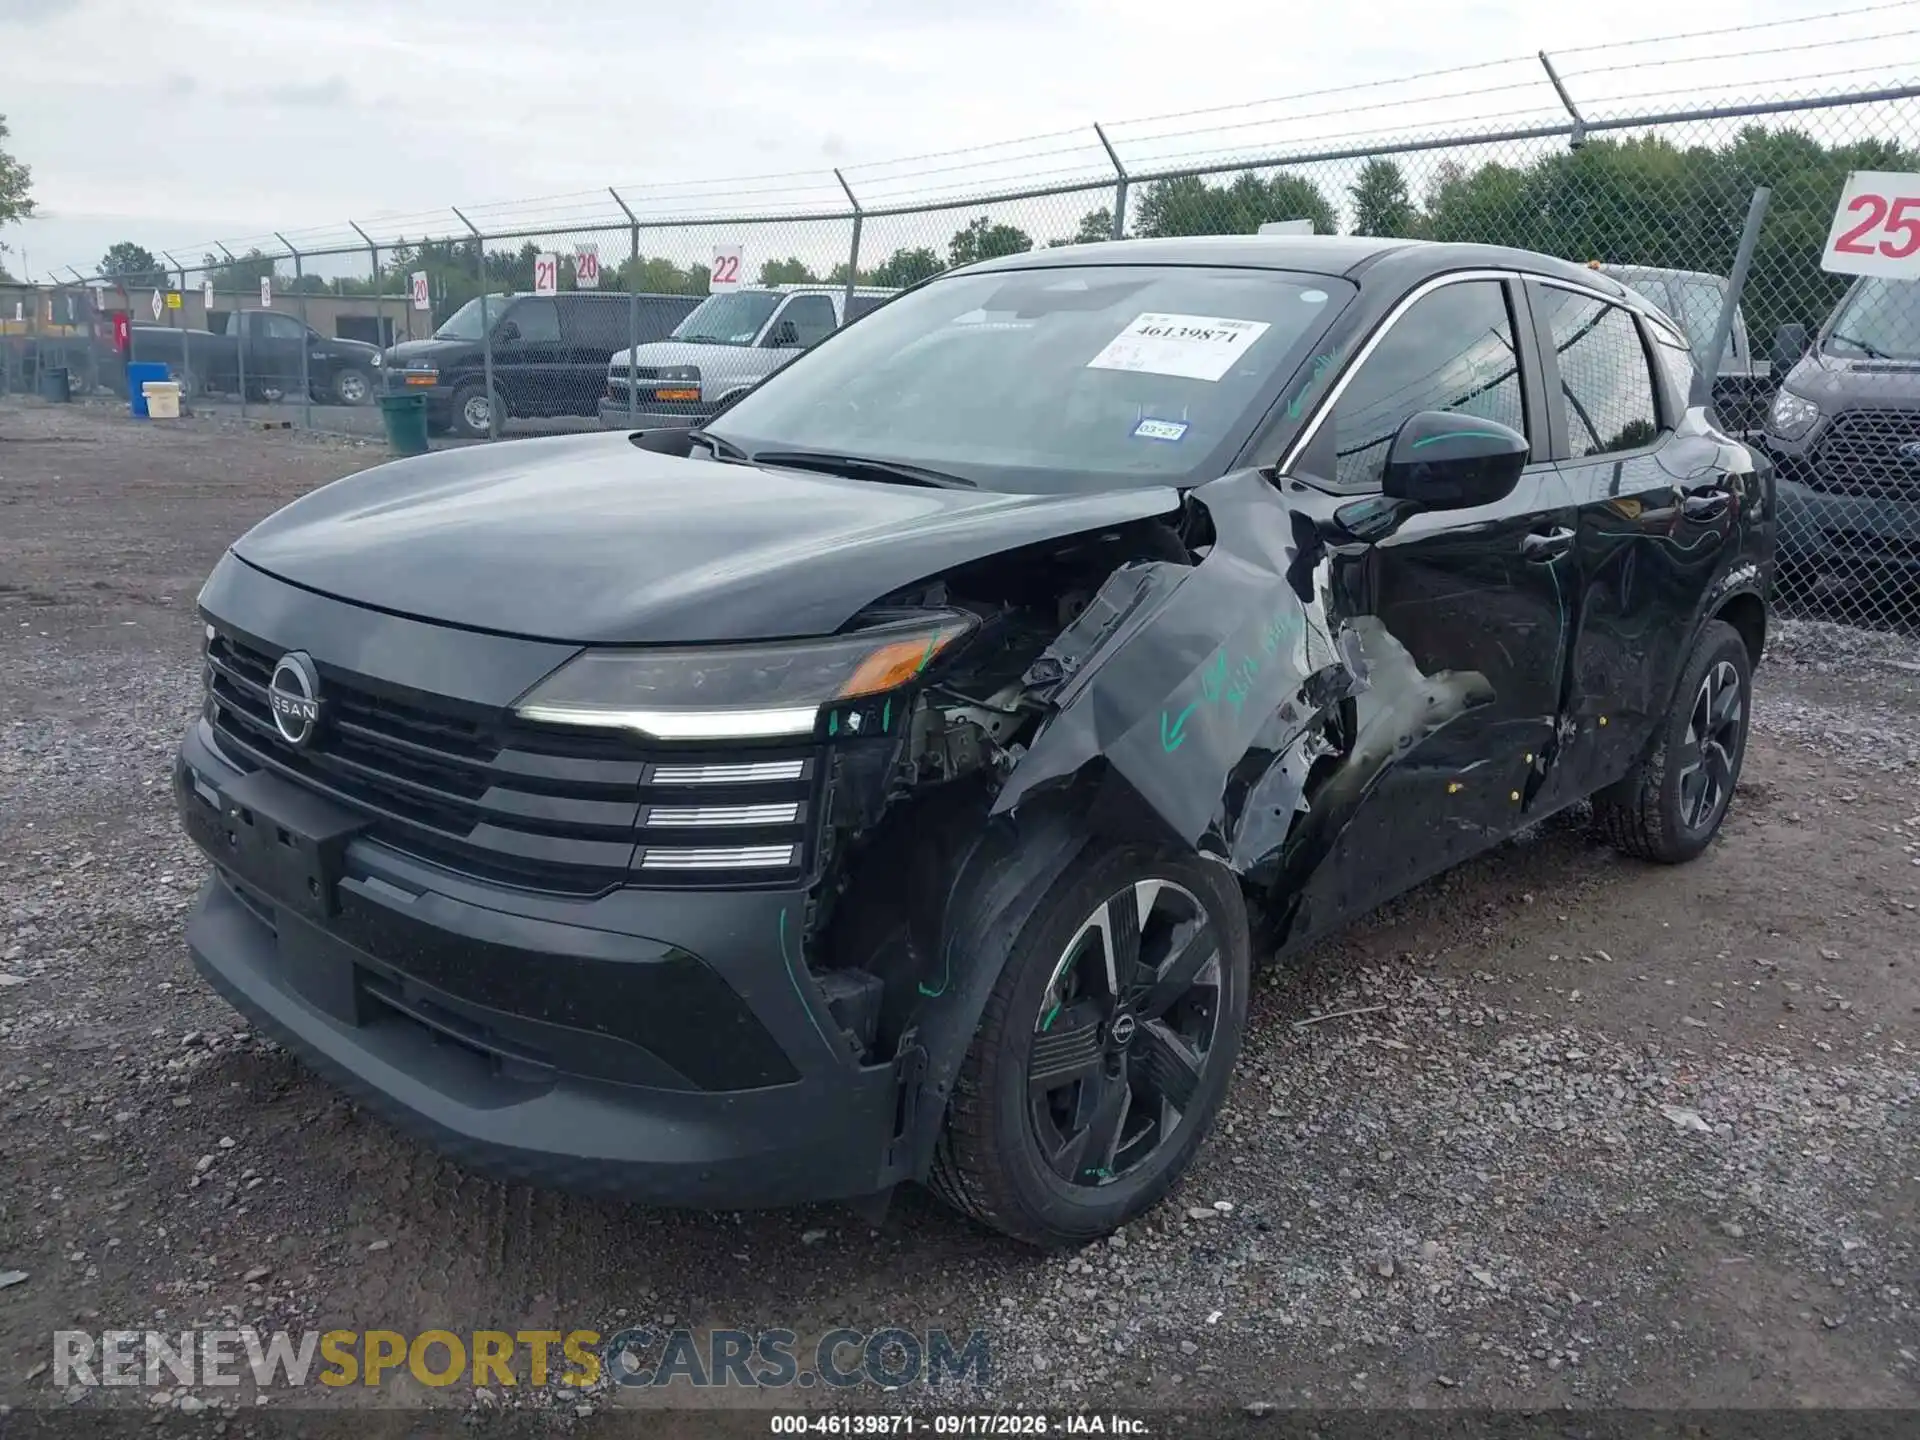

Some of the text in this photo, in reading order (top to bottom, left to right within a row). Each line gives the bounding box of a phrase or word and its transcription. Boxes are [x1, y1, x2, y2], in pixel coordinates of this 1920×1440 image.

[1834, 194, 1920, 259] 25
[537, 262, 555, 290] 21
[577, 253, 597, 279] 20
[712, 255, 738, 283] 22
[415, 279, 428, 302] 20
[1135, 325, 1239, 344] 46139871
